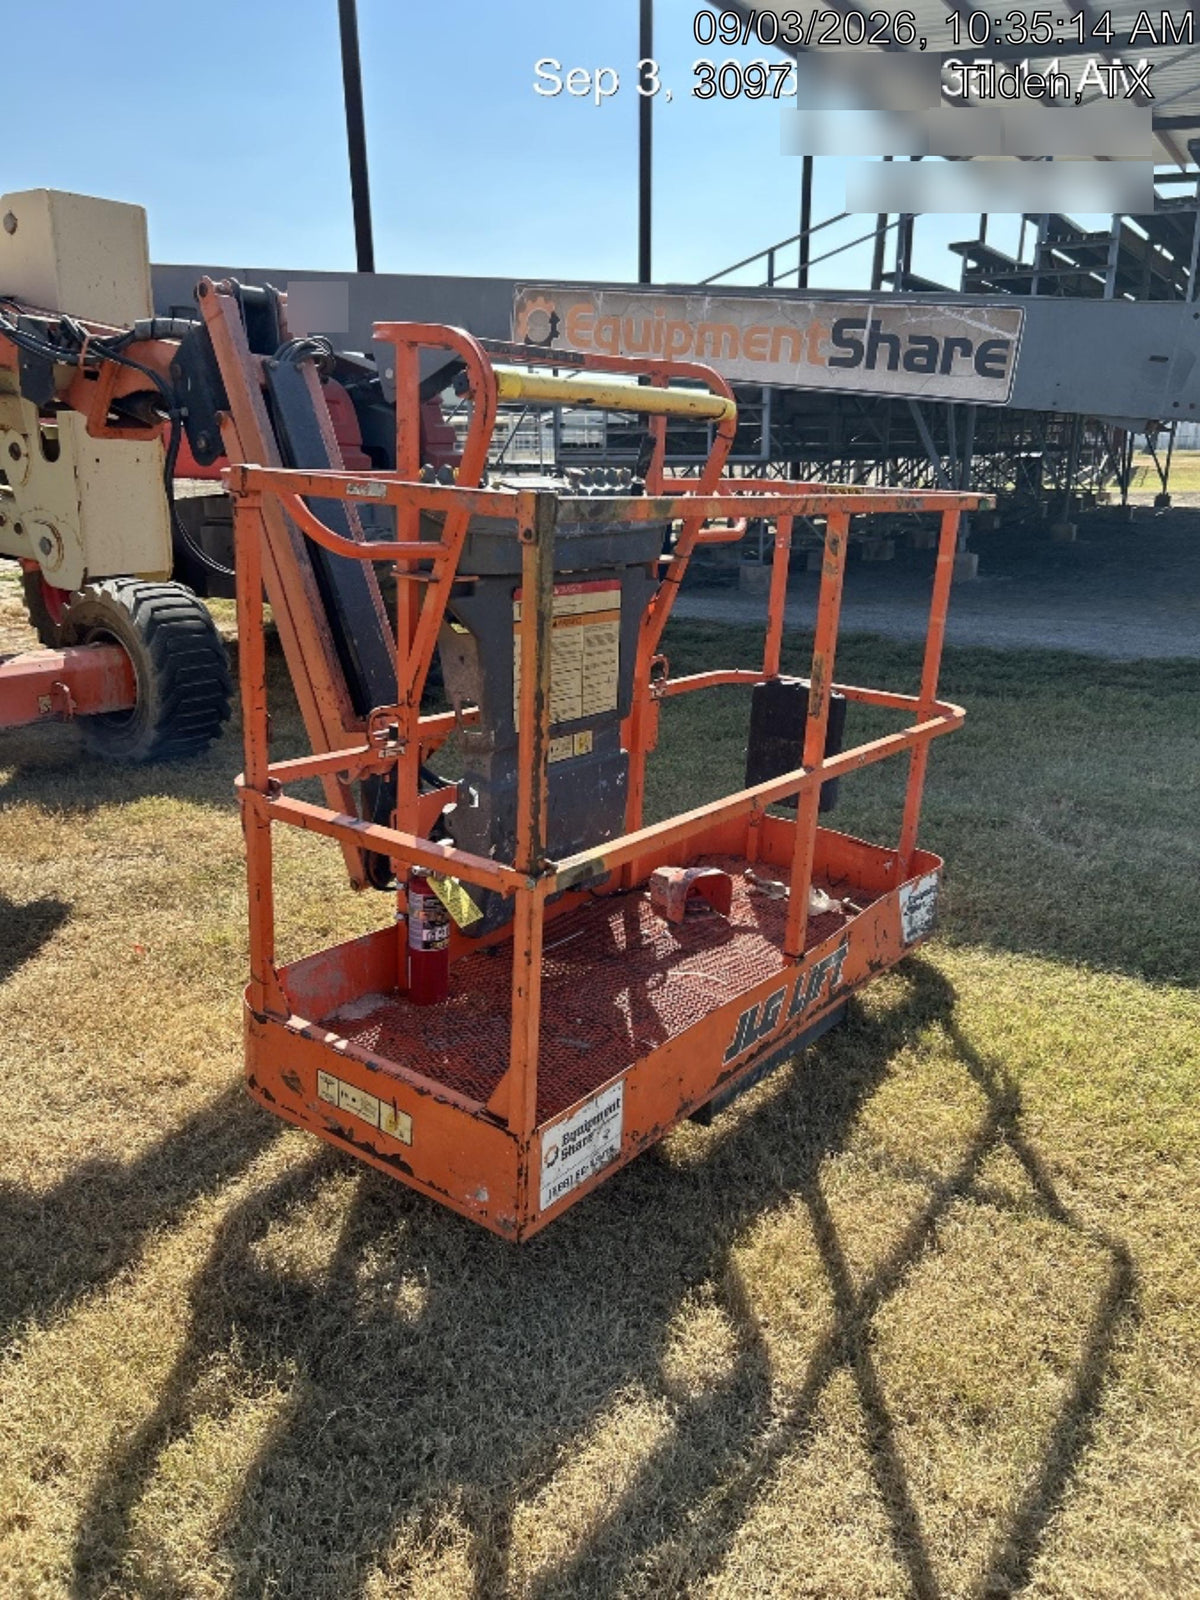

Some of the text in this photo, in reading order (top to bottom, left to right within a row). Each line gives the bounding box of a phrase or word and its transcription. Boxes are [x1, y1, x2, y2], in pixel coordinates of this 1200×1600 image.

[566, 301, 1011, 380] EquipmentShare
[722, 941, 849, 1066] JLG LIFT
